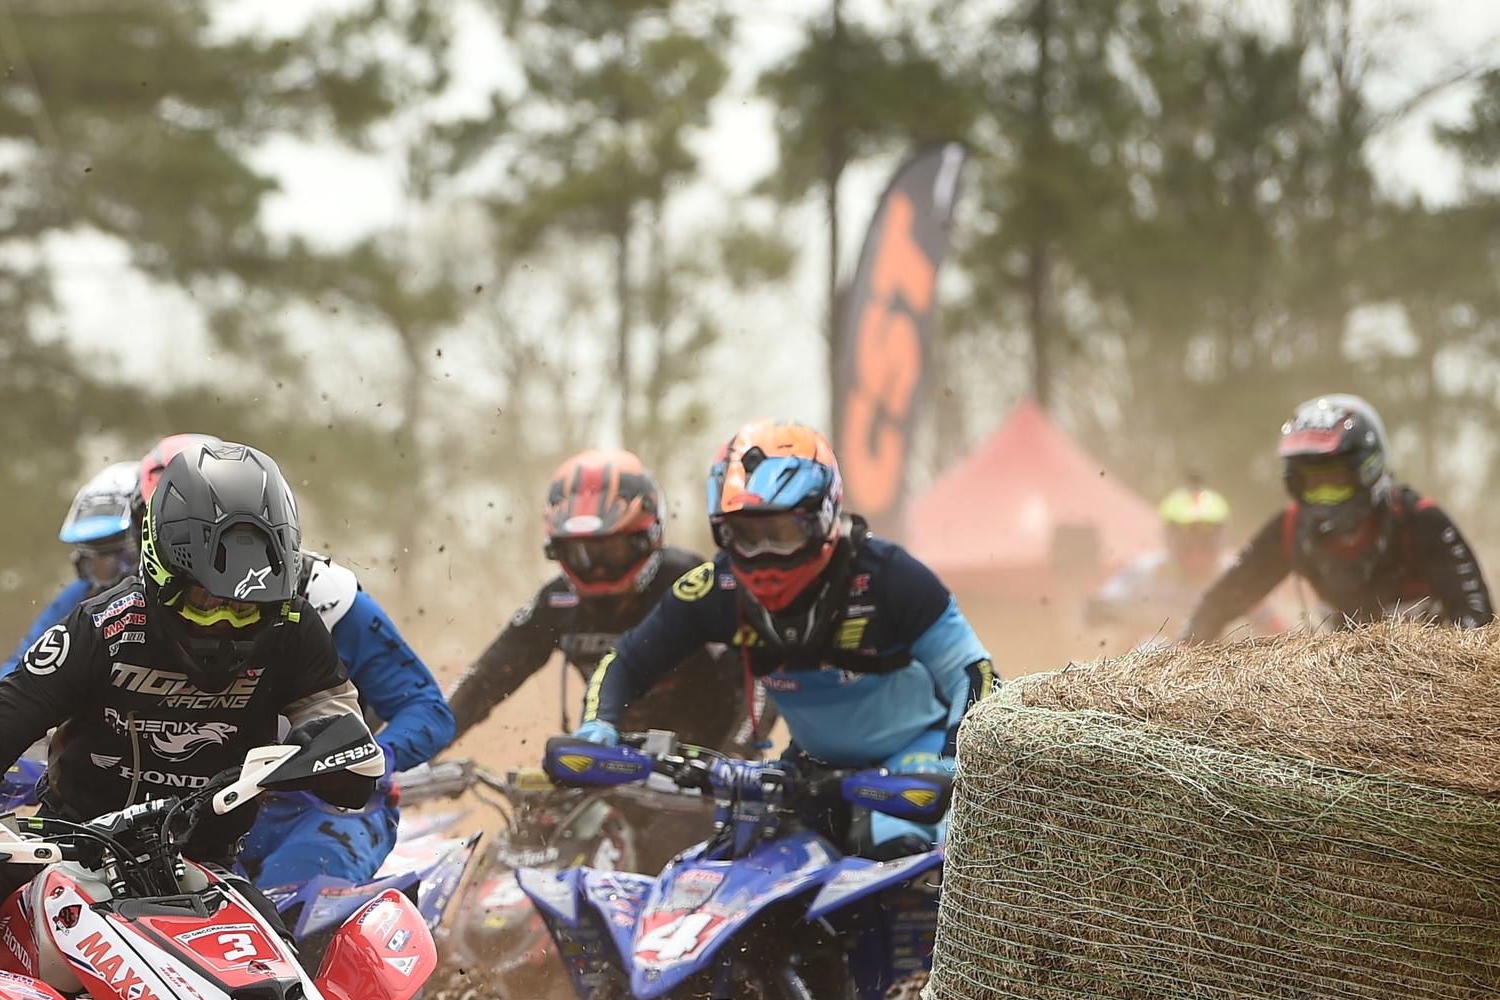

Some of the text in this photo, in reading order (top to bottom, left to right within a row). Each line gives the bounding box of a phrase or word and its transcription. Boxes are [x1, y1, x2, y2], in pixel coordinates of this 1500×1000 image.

[157, 694, 251, 709] RACING
[104, 707, 198, 735] PHOENIX
[312, 742, 377, 773] ACERBIS
[119, 765, 211, 789] HOND
[2, 926, 33, 977] HONDA
[217, 932, 258, 961] 3
